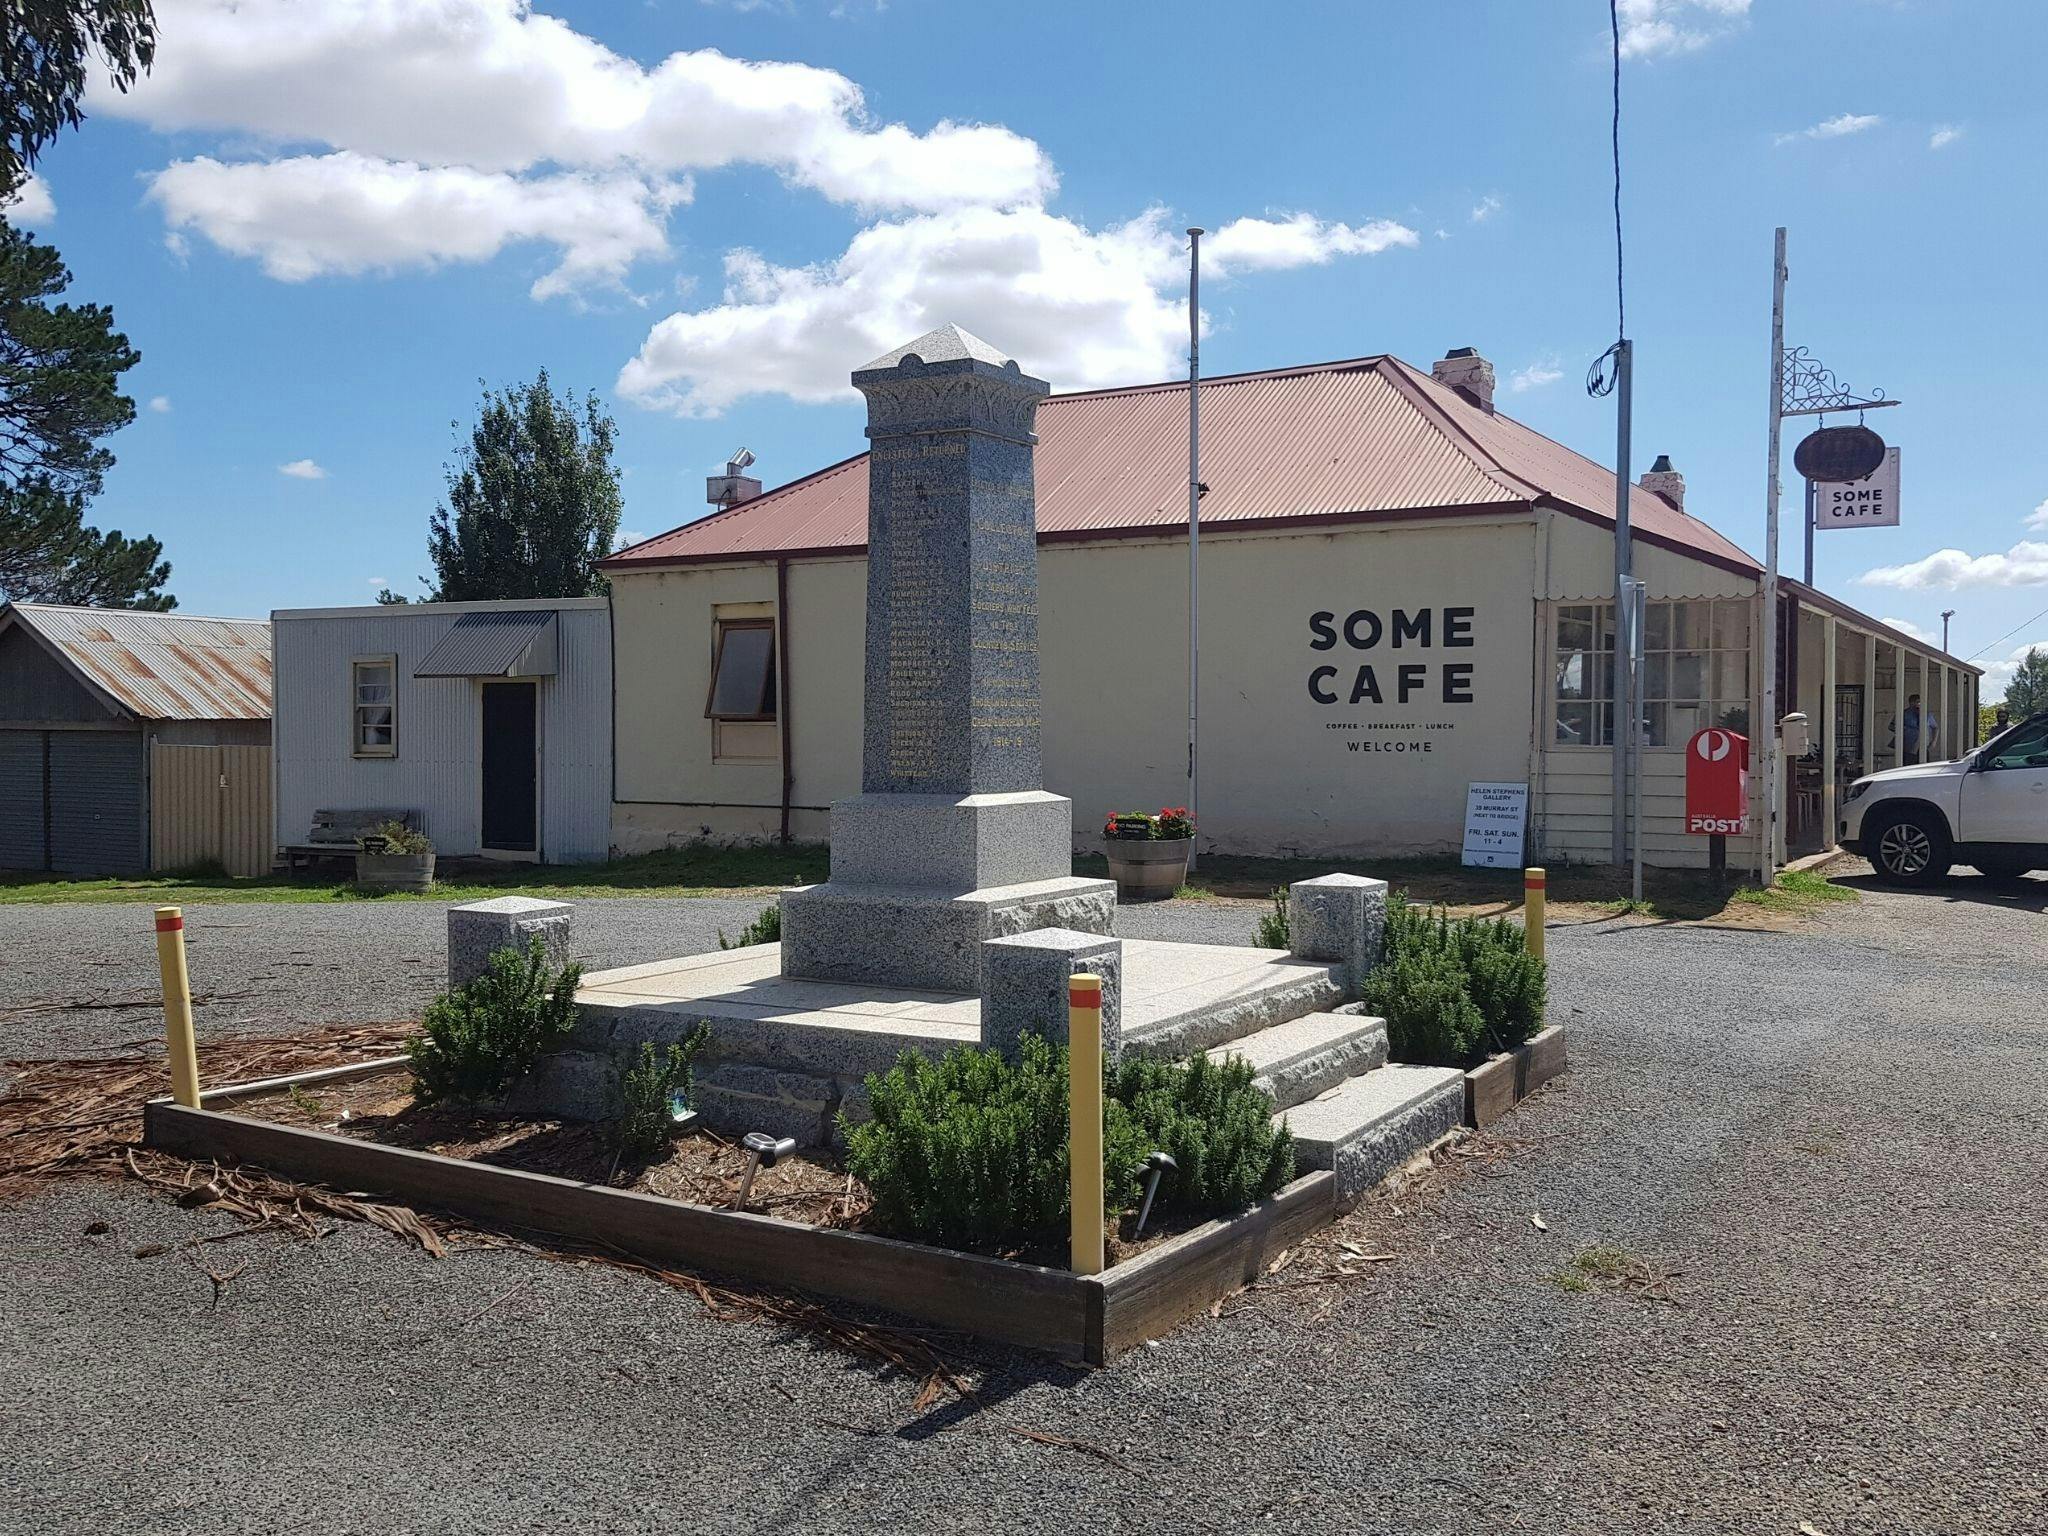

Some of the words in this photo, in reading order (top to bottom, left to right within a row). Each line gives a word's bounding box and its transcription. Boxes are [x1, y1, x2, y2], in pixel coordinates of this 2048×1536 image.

[1833, 489, 1882, 502] SOME
[1832, 504, 1882, 517] CAFE
[1309, 607, 1474, 650] SOME
[1308, 664, 1474, 704] CAFE
[1347, 742, 1432, 752] WELCOME
[1691, 819, 1740, 832] POST
